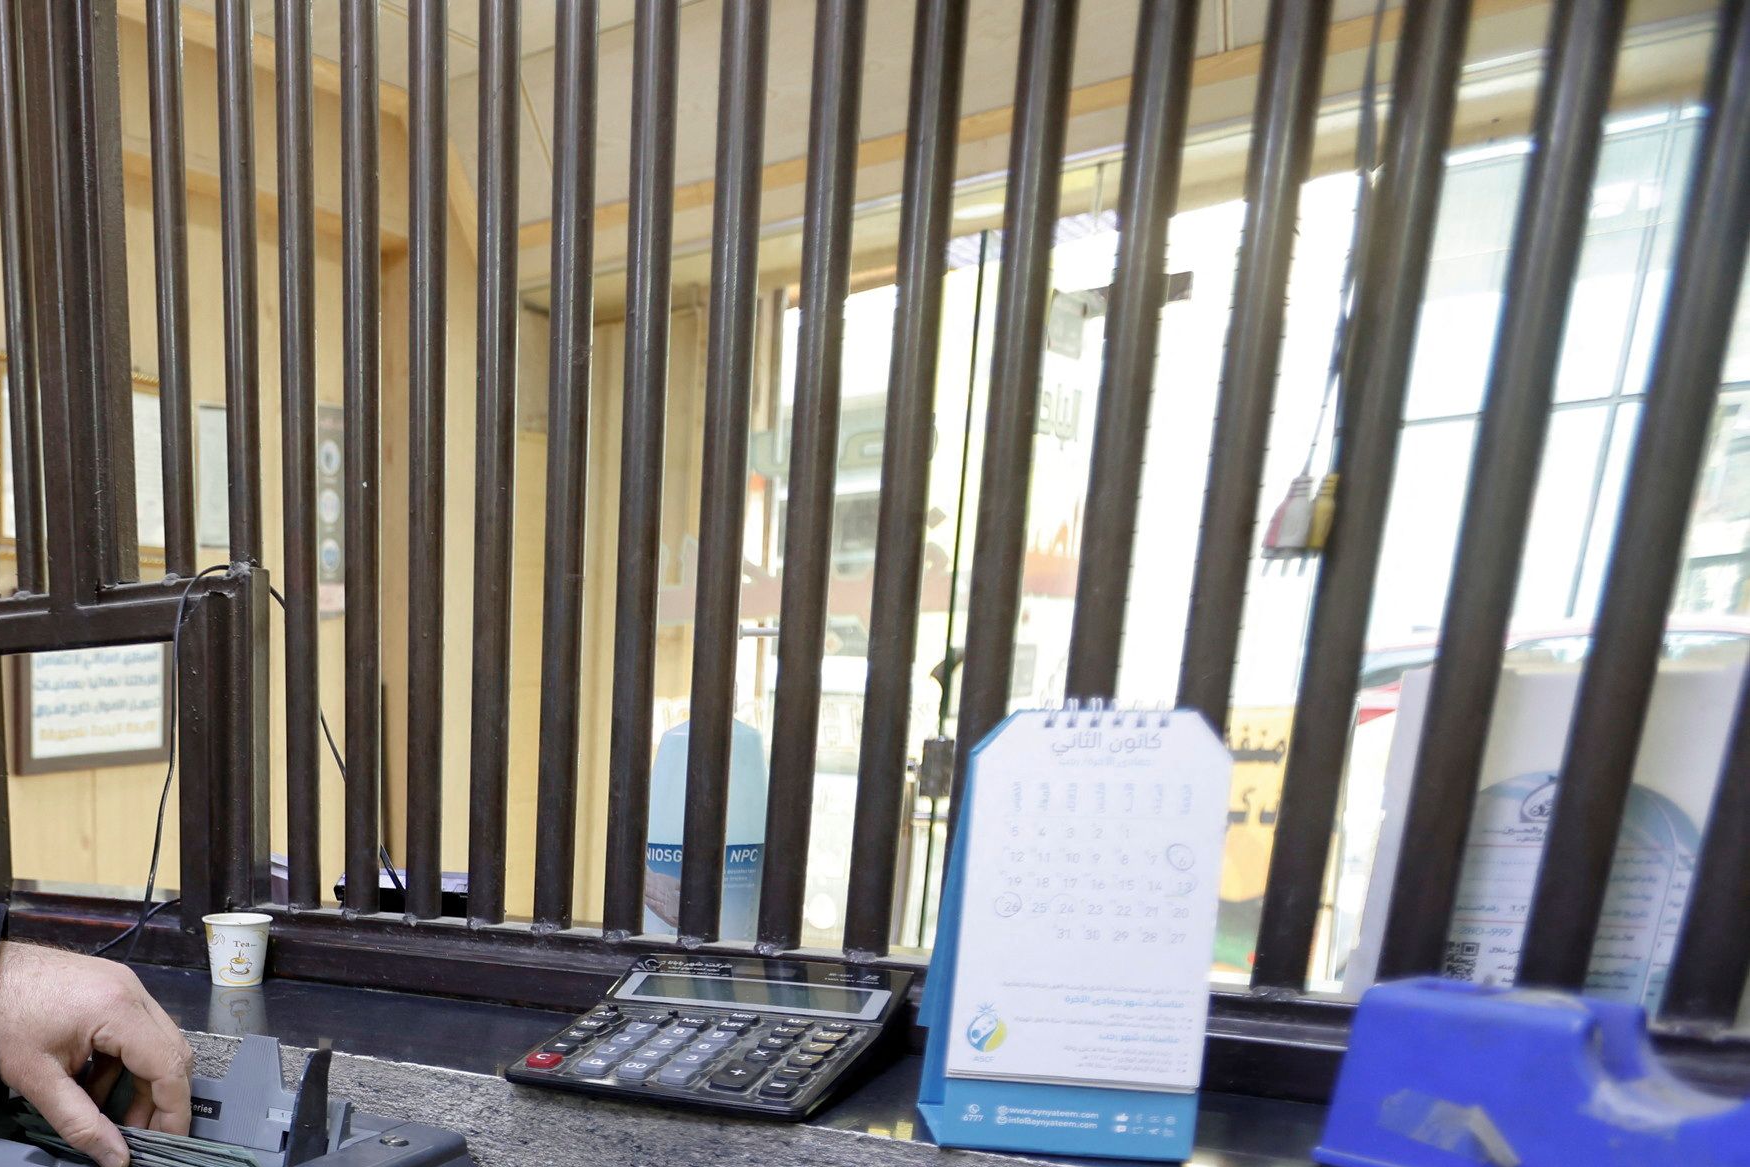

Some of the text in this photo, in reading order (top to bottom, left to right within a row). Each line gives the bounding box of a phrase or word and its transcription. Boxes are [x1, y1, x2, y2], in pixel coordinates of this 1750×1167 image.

[1052, 731, 1162, 756] كانون الثاني
[646, 847, 759, 863] NIOSG NPC
[1010, 851, 1026, 863] 12
[1038, 852, 1051, 864] 11
[1066, 853, 1081, 864] 10
[1007, 876, 1192, 893] 19 18 17 16 15 14 13
[1004, 901, 1189, 919] 26 25 24 23 22 21 20
[233, 939, 251, 948] Tea
[1057, 928, 1186, 944] 31 30 29 28 27
[962, 1113, 984, 1123] 6777
[1009, 1107, 1099, 1119] www.aynyateem.com
